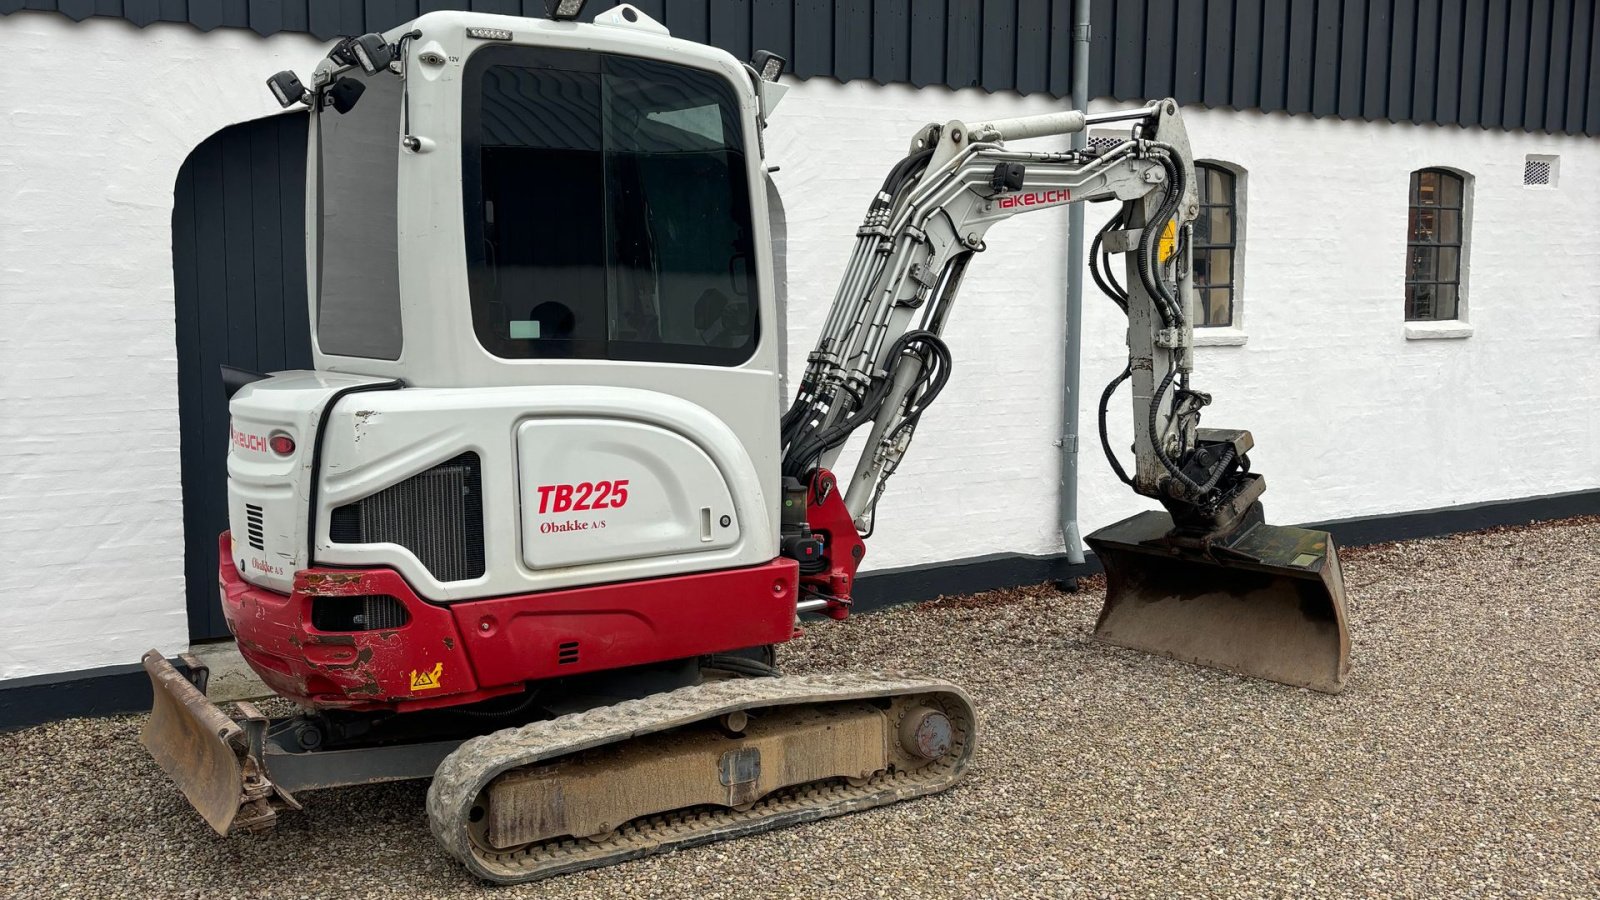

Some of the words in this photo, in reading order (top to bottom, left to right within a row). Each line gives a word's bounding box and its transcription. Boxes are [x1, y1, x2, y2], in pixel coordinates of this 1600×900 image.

[537, 479, 629, 514] TB225
[540, 519, 588, 534] Øbakke
[591, 519, 606, 529] A/S
